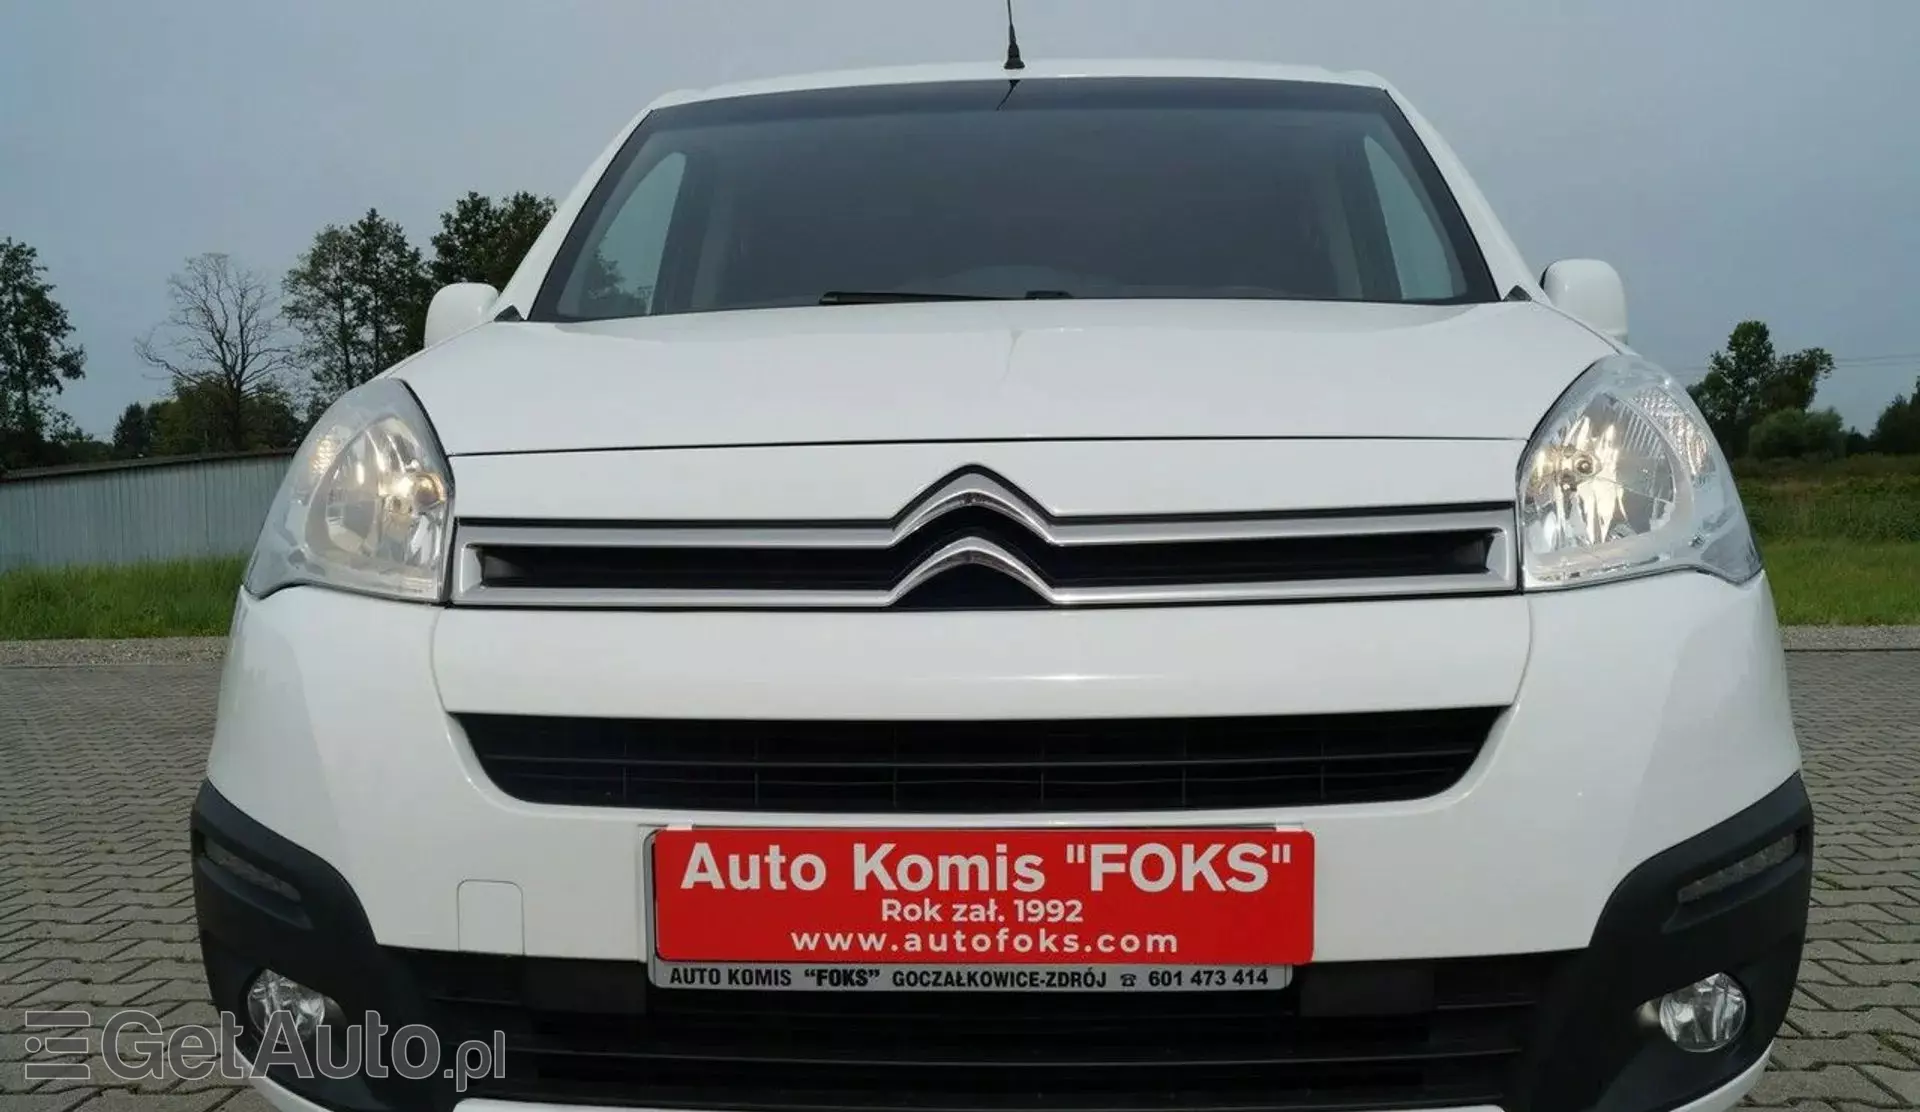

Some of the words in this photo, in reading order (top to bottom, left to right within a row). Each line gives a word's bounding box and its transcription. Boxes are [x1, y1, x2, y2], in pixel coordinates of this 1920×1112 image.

[680, 842, 827, 892] Auto
[853, 843, 1046, 893] Komis
[1066, 843, 1292, 893] "FOKS"
[881, 899, 943, 923] Rok
[951, 899, 1006, 924] zał.
[1013, 899, 1084, 923] 1992
[790, 928, 1178, 953] www.autofoks.com
[669, 968, 721, 985] AUTO
[727, 969, 792, 987] KOMIS
[891, 967, 1108, 988] GOCZAŁKOWICE-ZDRÓJ
[1148, 970, 1183, 987] 601
[1190, 970, 1227, 987] 473
[1232, 969, 1269, 986] 414
